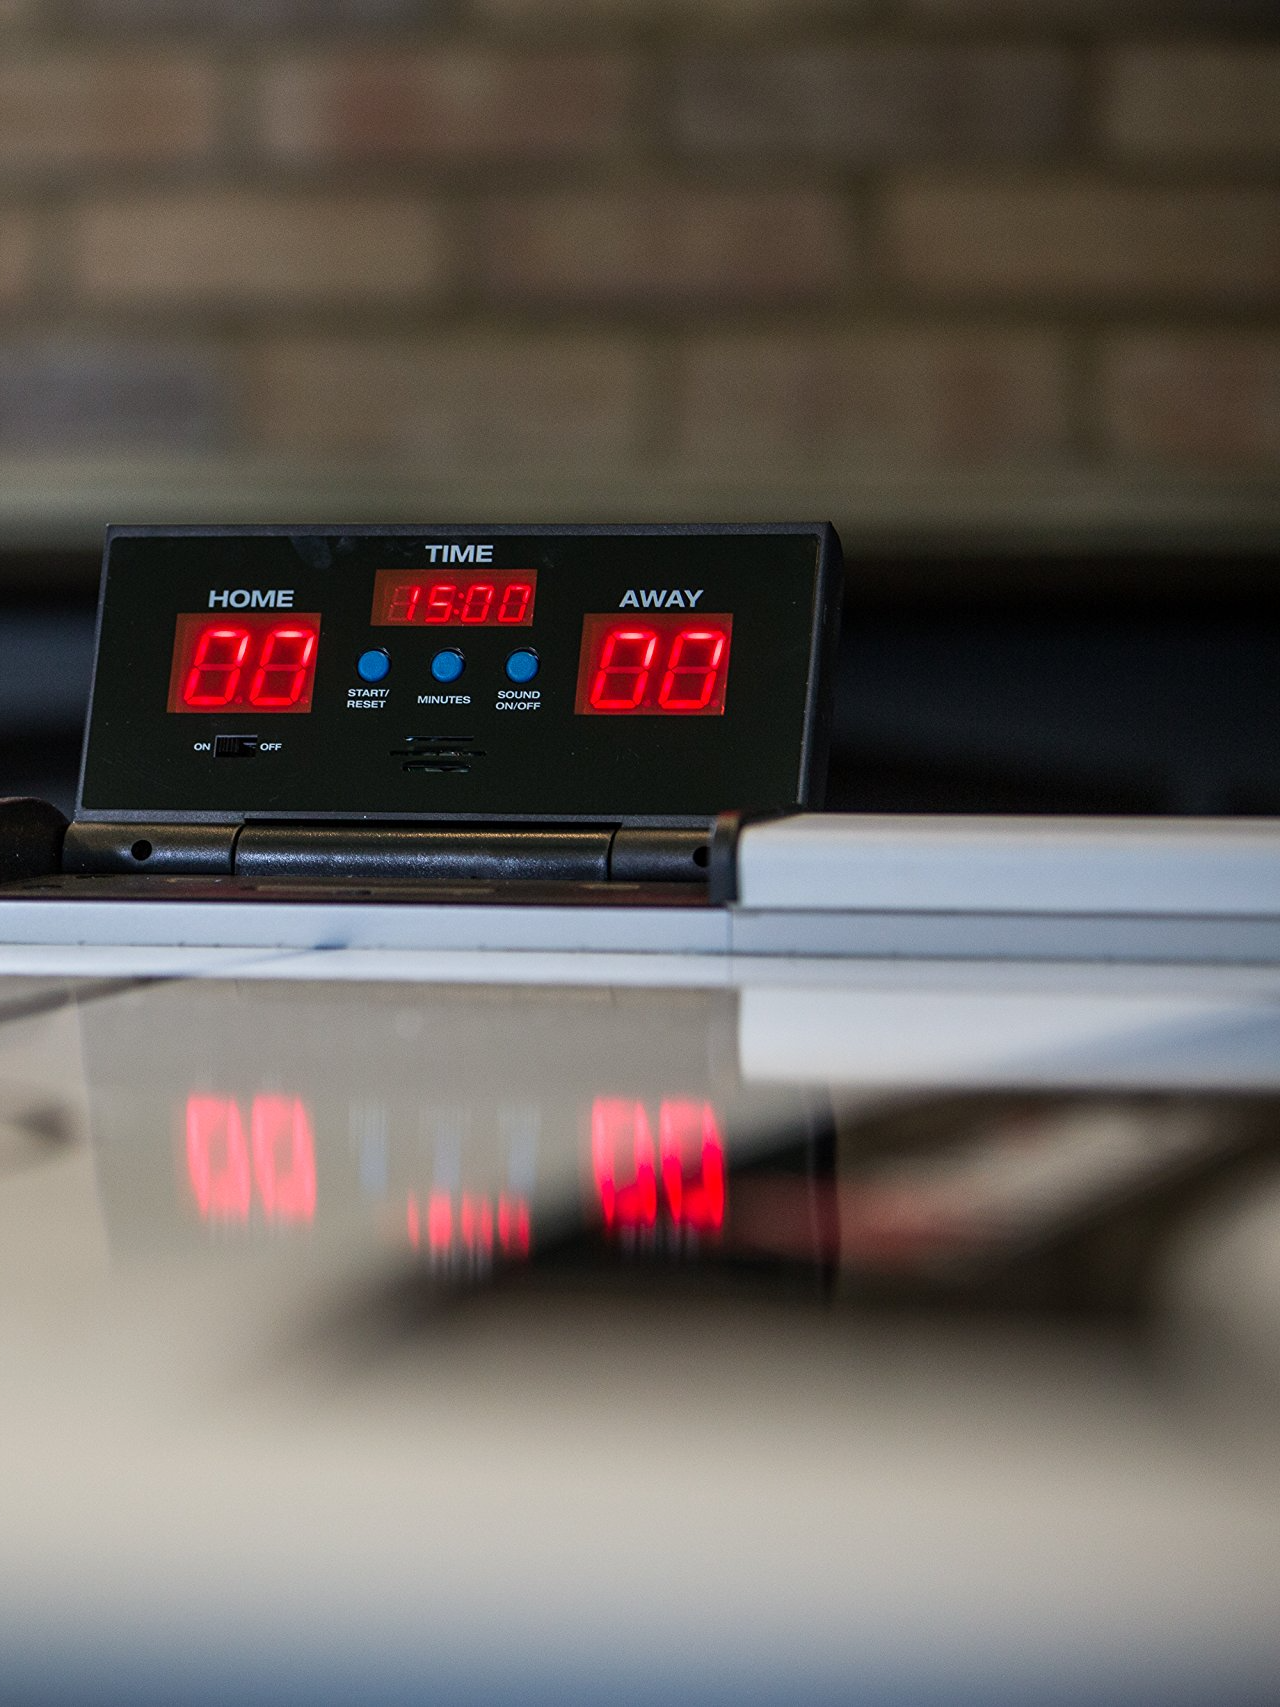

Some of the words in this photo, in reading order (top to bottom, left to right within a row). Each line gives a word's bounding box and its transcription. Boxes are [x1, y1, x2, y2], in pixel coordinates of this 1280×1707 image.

[424, 544, 494, 563] TIME
[208, 589, 295, 608] HOME
[405, 584, 532, 623] 15:00
[618, 589, 704, 608] AWAY
[183, 628, 316, 706] 00
[589, 630, 726, 709] 00
[347, 688, 390, 698] START/
[497, 690, 541, 700] SOUND
[346, 699, 386, 709] RESET
[417, 695, 471, 705] MINUTES
[495, 701, 541, 711] ON/OFF
[193, 742, 211, 751] ON
[259, 742, 283, 751] OFF
